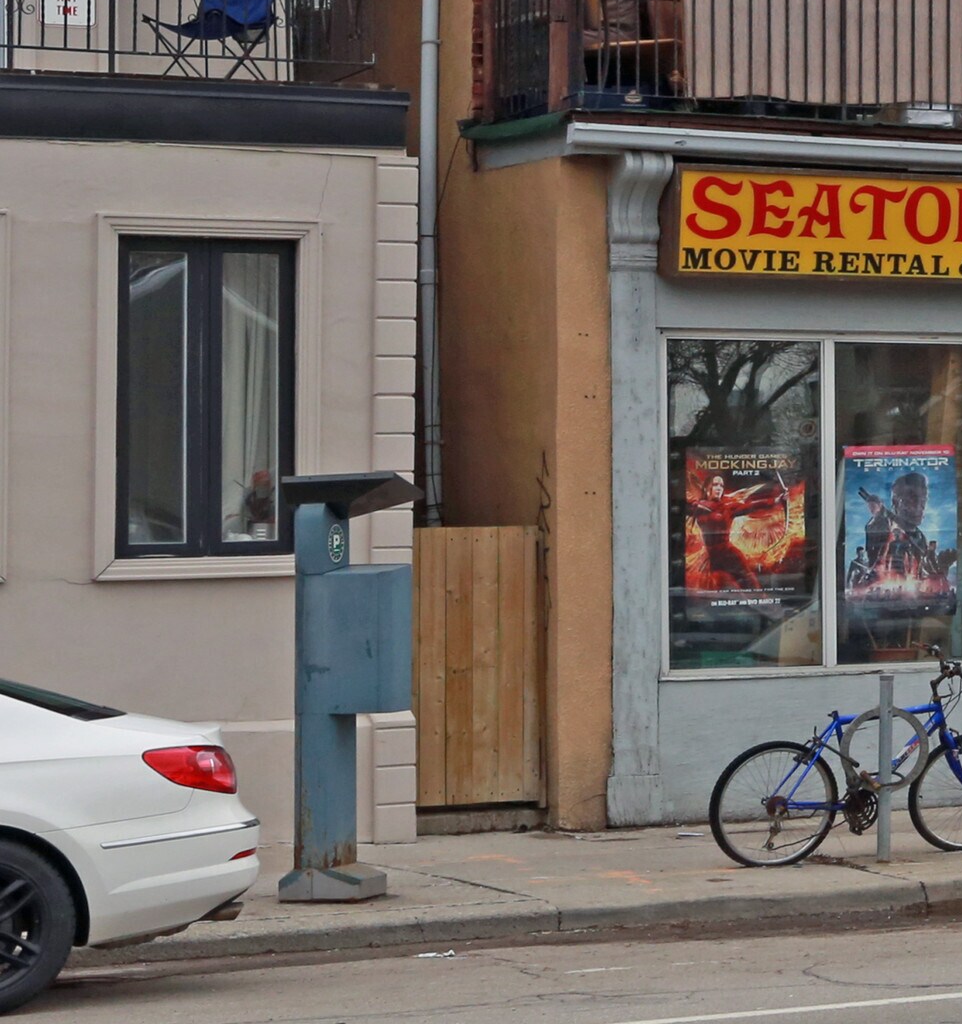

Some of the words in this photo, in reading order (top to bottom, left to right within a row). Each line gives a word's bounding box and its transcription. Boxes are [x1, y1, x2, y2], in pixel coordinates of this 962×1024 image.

[682, 247, 800, 272] MOVIE
[812, 251, 950, 276] RENTAL
[695, 459, 797, 470] MOCKINGJAY
[853, 457, 949, 468] TERMINATOR
